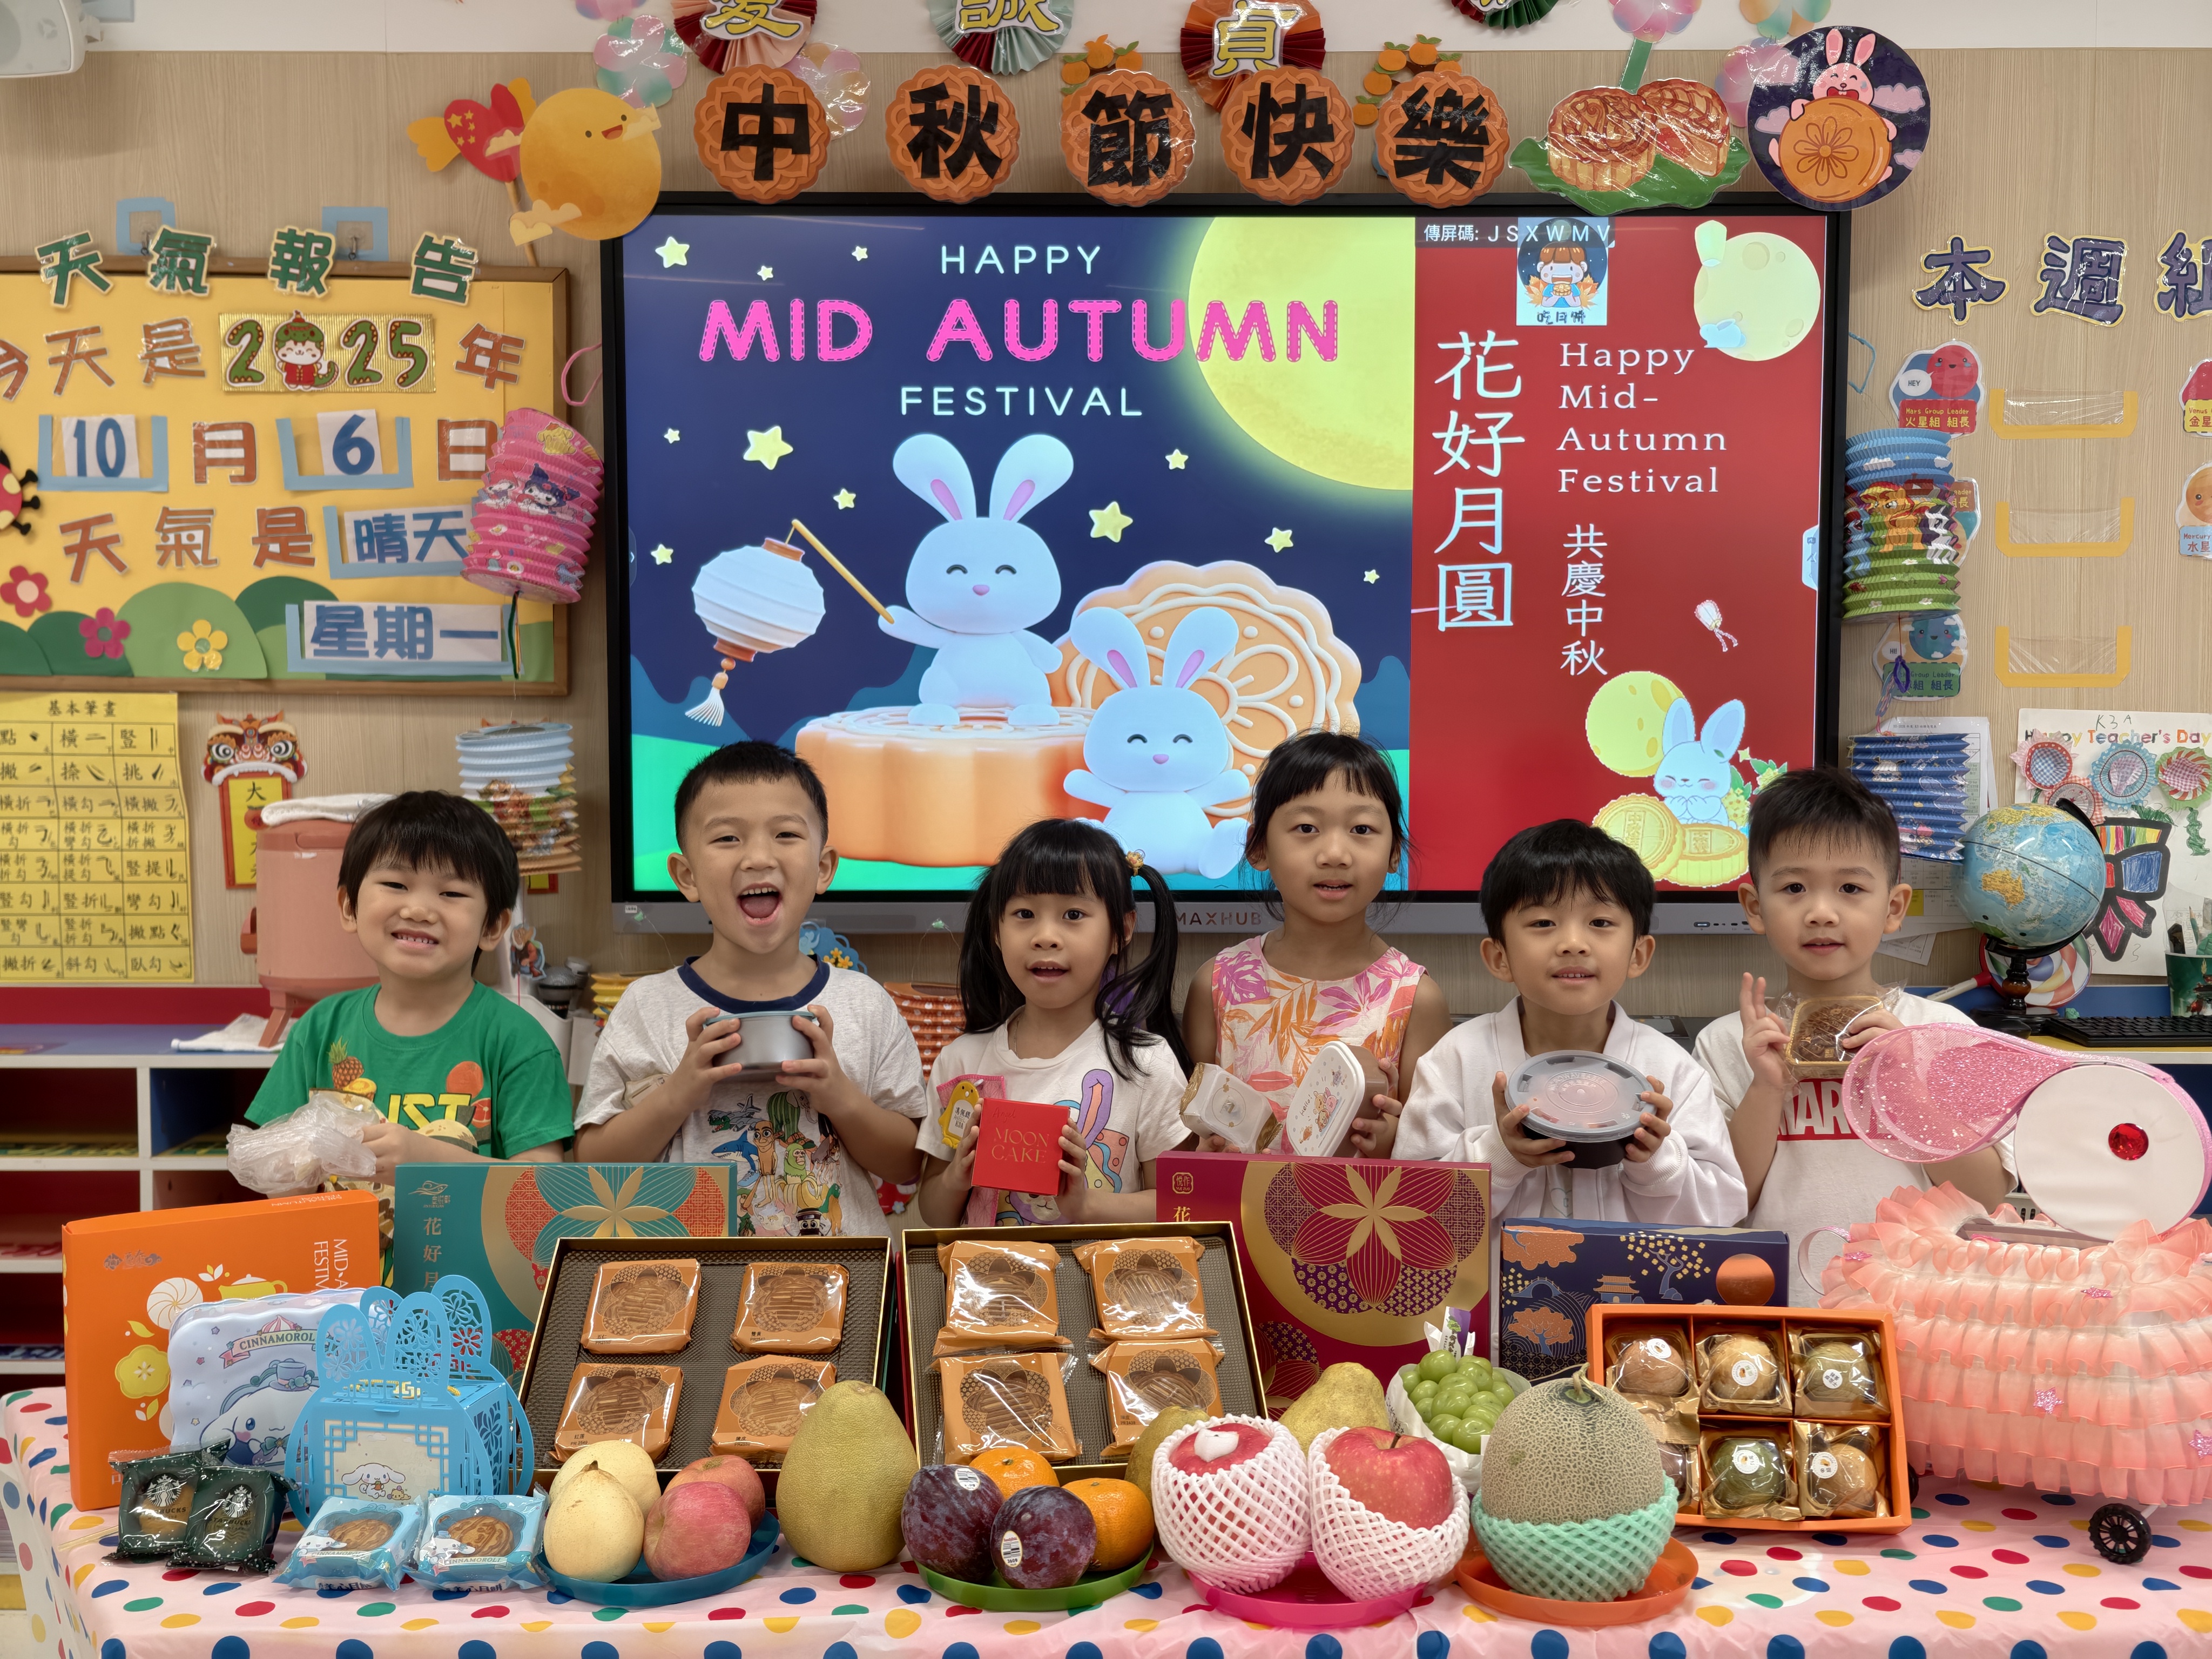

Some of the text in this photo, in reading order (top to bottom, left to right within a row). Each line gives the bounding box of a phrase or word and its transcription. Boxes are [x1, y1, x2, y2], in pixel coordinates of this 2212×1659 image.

[720, 82, 1489, 189] 中秋節快樂
[37, 227, 478, 306] 天氣報告
[942, 245, 1101, 274] HAPPY
[699, 299, 1338, 361] MID AUTUMN
[455, 323, 525, 391] 年
[1560, 343, 1695, 375] Happy
[901, 387, 1143, 416] FESTIVAL
[1559, 382, 1658, 409] Mid-
[1906, 416, 1970, 428] 火星組 組長
[1556, 427, 1727, 451] Autumn
[1432, 329, 1525, 632] 花好月圓
[1558, 467, 1718, 494] Festival
[58, 506, 316, 584] 天氣是
[2183, 532, 2210, 543] Mercury
[1561, 524, 1608, 676] 共慶中秋
[311, 605, 499, 662] 星期一
[1931, 680, 1954, 691] 組長
[48, 699, 117, 717] 基本筆畫
[2087, 729, 2171, 745] Teacher's
[2177, 729, 2211, 746] Day
[1176, 912, 1262, 925] MAXHUB
[993, 1108, 1015, 1123] Angel
[994, 1127, 1049, 1147] MOON
[992, 1144, 1047, 1163] CAKE
